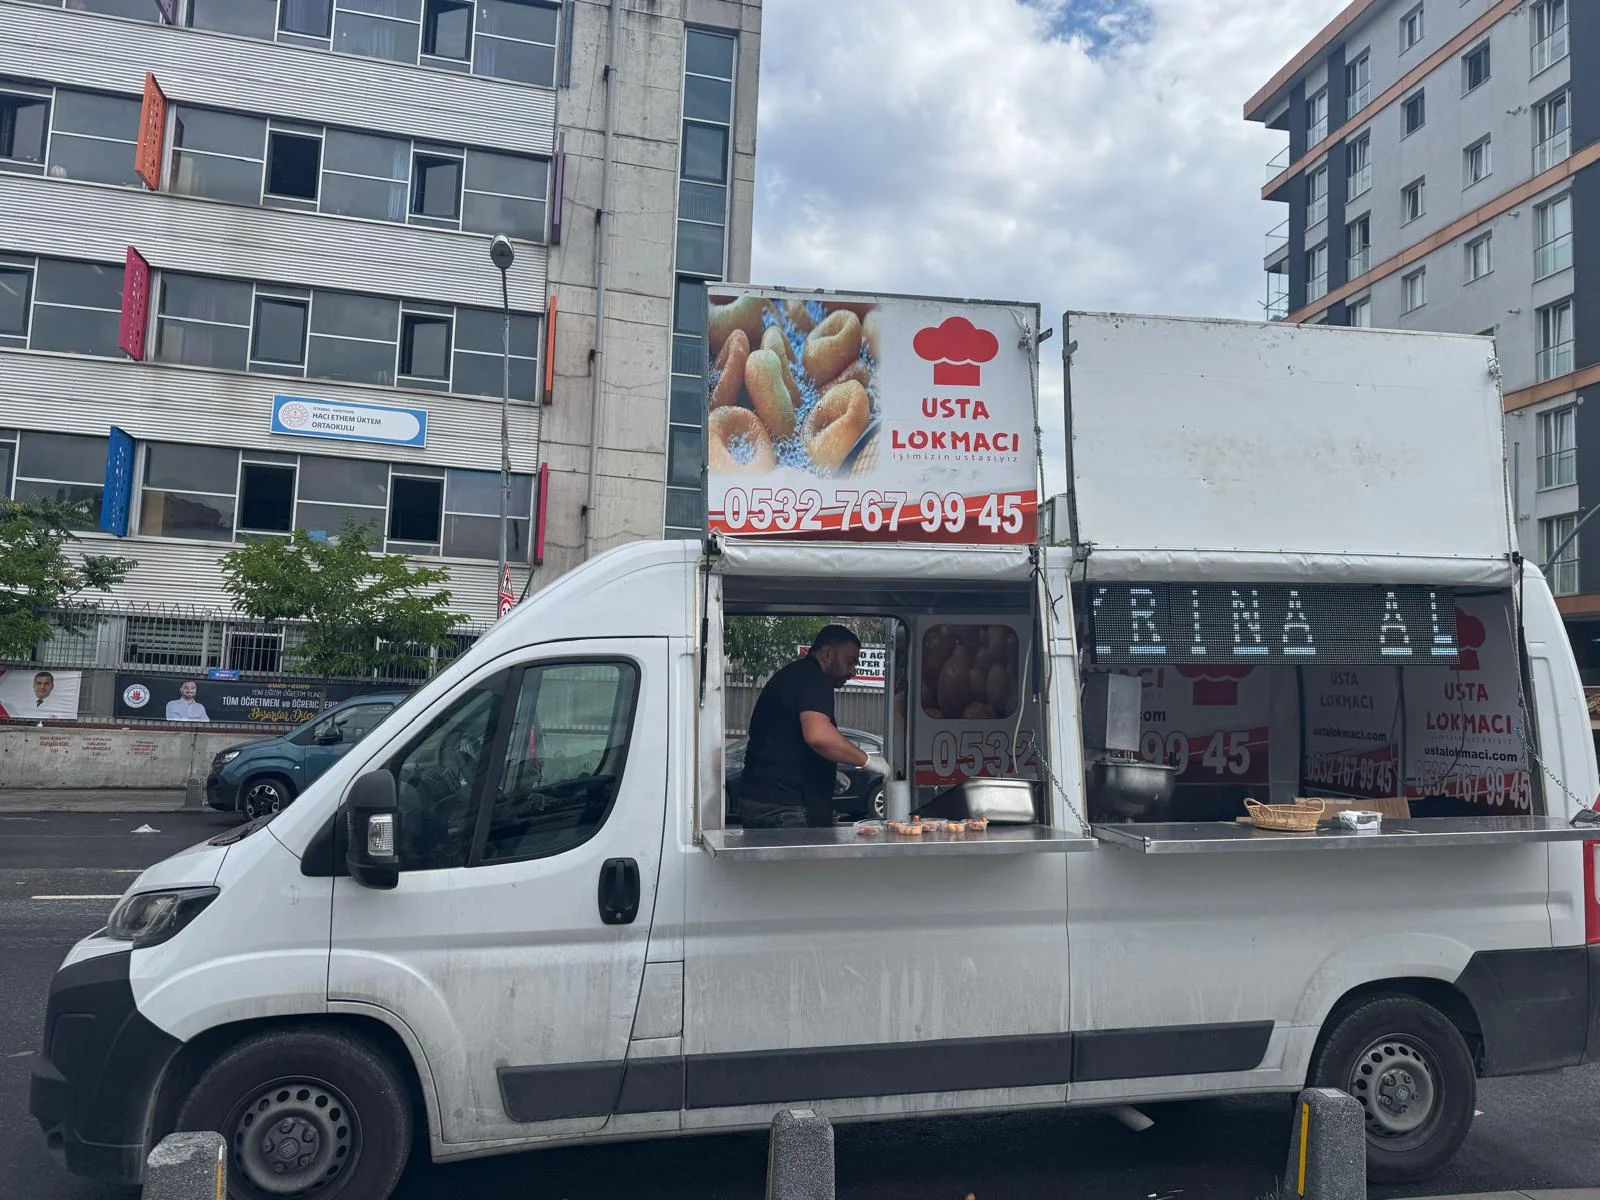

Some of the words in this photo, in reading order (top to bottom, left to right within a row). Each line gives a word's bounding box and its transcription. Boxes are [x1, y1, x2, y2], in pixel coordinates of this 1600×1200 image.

[312, 412, 330, 420] HACI
[331, 414, 355, 422] ETHEM
[356, 415, 382, 425] ÜKTEM
[921, 397, 990, 420] USTA
[311, 421, 355, 431] ORTAOKULU
[891, 429, 1020, 452] LOKMACI
[892, 451, 950, 461] işimizin
[723, 486, 823, 530] 0532
[835, 489, 908, 532] 767
[919, 491, 966, 533] 99
[977, 493, 1024, 535] 45
[1330, 670, 1360, 687] USTA
[222, 695, 239, 706] TÜM
[240, 696, 280, 708] ÖĞRETMEN
[281, 700, 291, 708] ve
[1320, 693, 1374, 710] LOKMACI
[1444, 681, 1489, 702] USTA
[1426, 710, 1512, 735] LOKMACI
[1313, 726, 1388, 742] ustalokmaci.com
[931, 730, 1037, 779] 0532
[1139, 729, 1190, 776] 99
[1202, 729, 1251, 776] 45
[1424, 746, 1518, 763] ustalokmaci.com
[1359, 756, 1376, 791] 99
[1376, 759, 1393, 794] 45
[1454, 762, 1481, 804] 767
[1485, 765, 1505, 807] 99
[1509, 768, 1530, 811] 45
